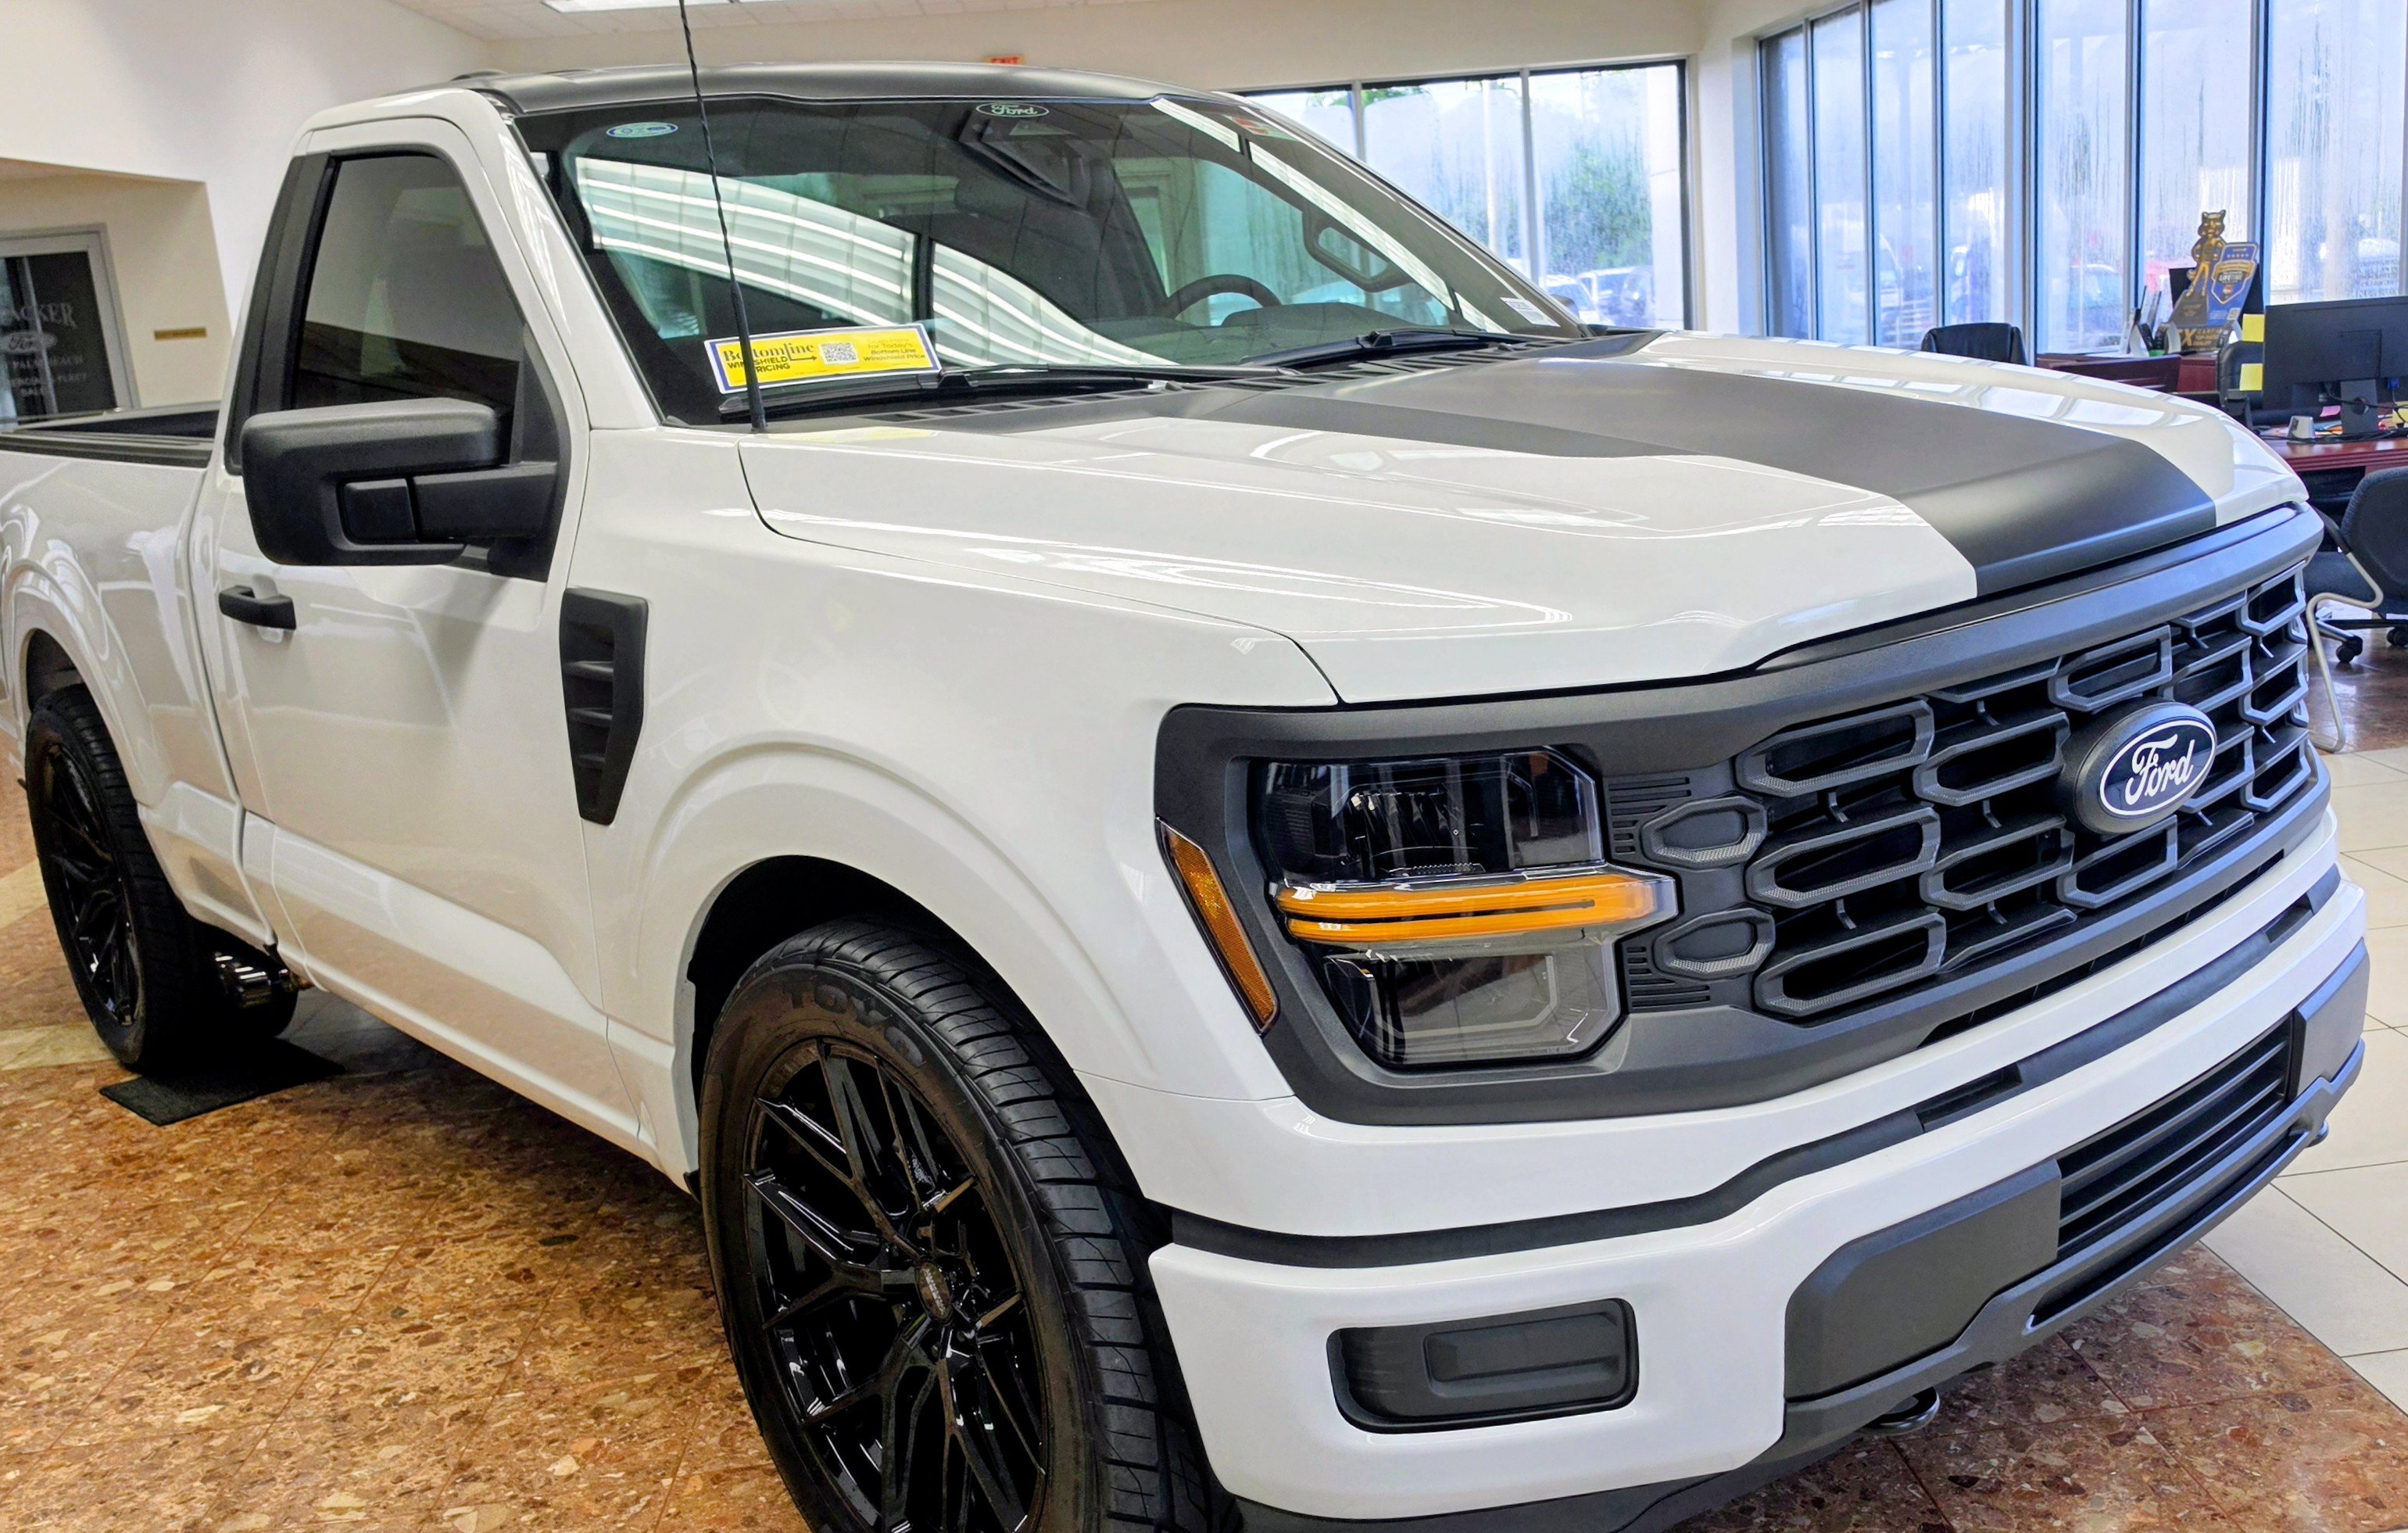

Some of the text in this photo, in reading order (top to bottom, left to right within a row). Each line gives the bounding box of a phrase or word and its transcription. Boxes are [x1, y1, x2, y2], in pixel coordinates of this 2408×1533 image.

[991, 104, 1038, 115] Ford
[723, 343, 814, 362] Botomline
[727, 356, 789, 370] WINSHIELD
[755, 363, 791, 374] RICING
[2124, 733, 2195, 805] Ford
[782, 979, 924, 1069] TOYO
